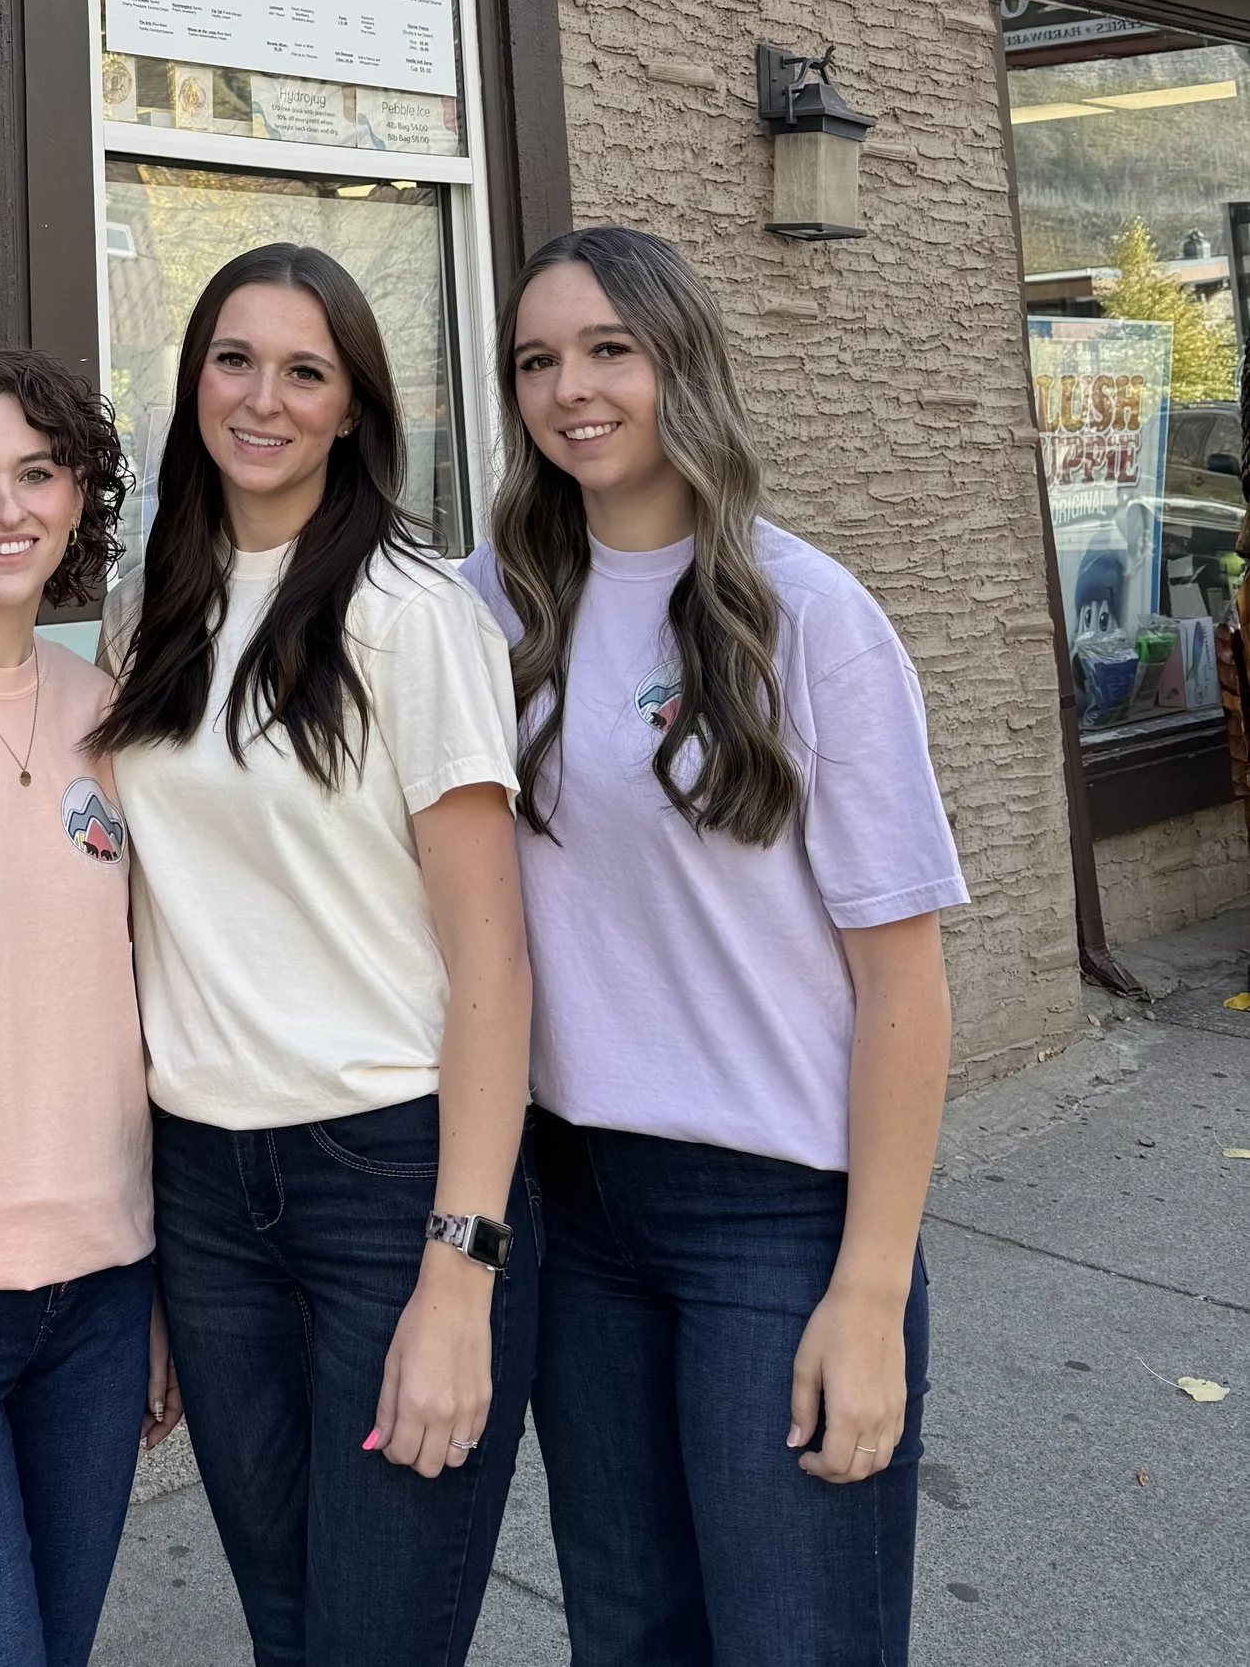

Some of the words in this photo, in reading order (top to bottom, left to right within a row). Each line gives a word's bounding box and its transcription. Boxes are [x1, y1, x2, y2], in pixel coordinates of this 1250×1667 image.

[279, 87, 326, 108] Hydrojug
[382, 102, 414, 116] Pebble
[417, 105, 430, 117] Ice
[398, 122, 409, 132] Bag
[399, 135, 410, 143] Bag
[1052, 489, 1106, 525] ORIGINAL
